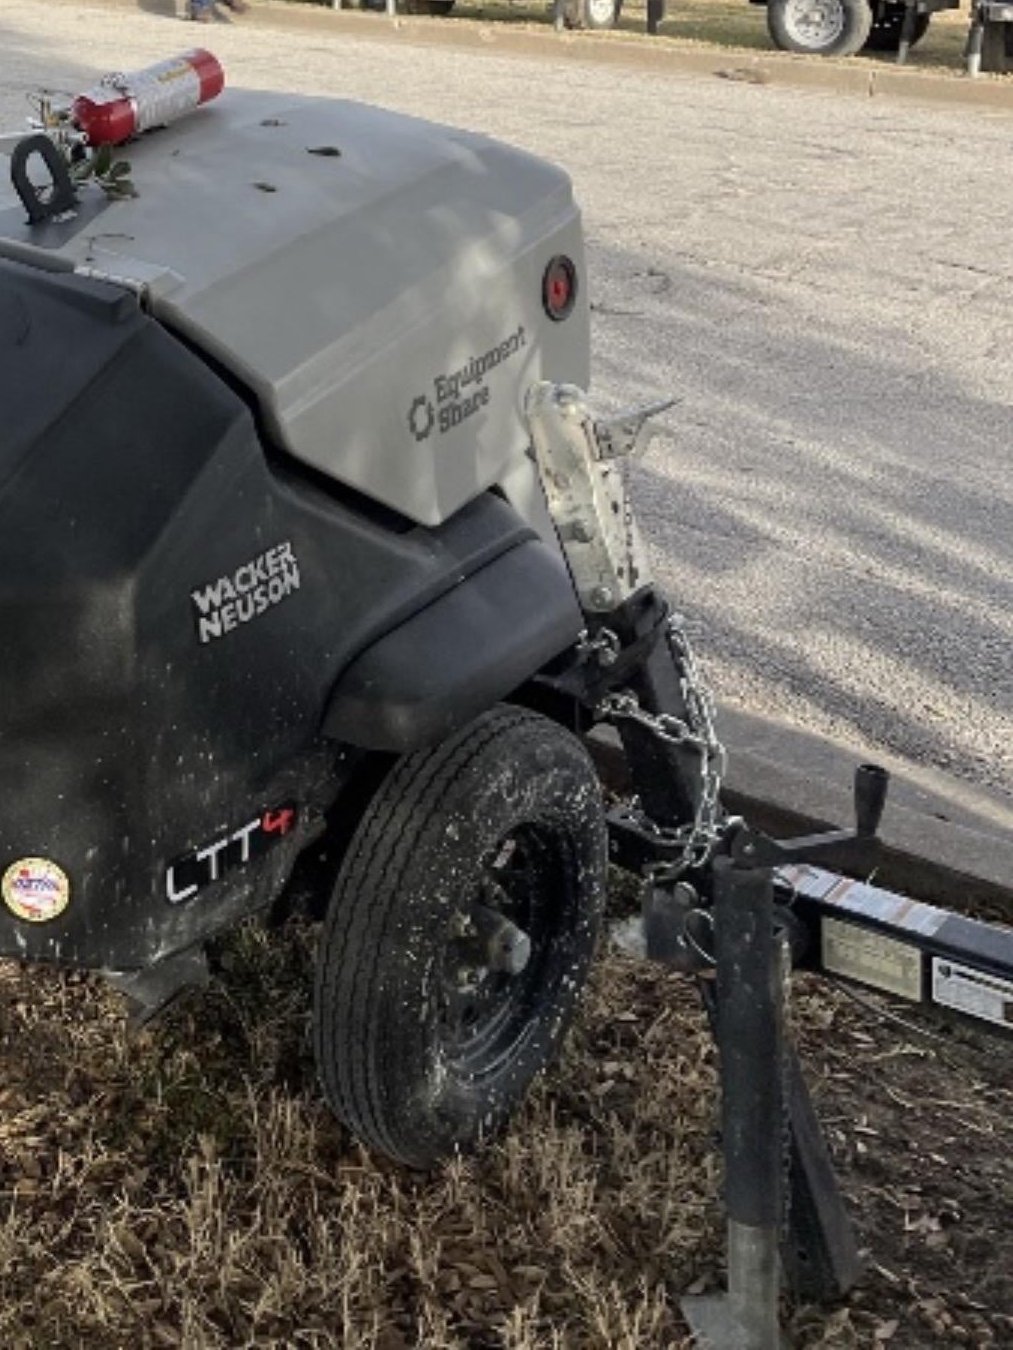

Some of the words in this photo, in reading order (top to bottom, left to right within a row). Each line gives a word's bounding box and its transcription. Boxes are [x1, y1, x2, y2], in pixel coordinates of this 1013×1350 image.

[434, 325, 526, 403] Equipment
[438, 385, 490, 434] Share
[190, 541, 298, 614] WACKER
[198, 561, 301, 644] NEUSON
[166, 808, 294, 904] LTT4
